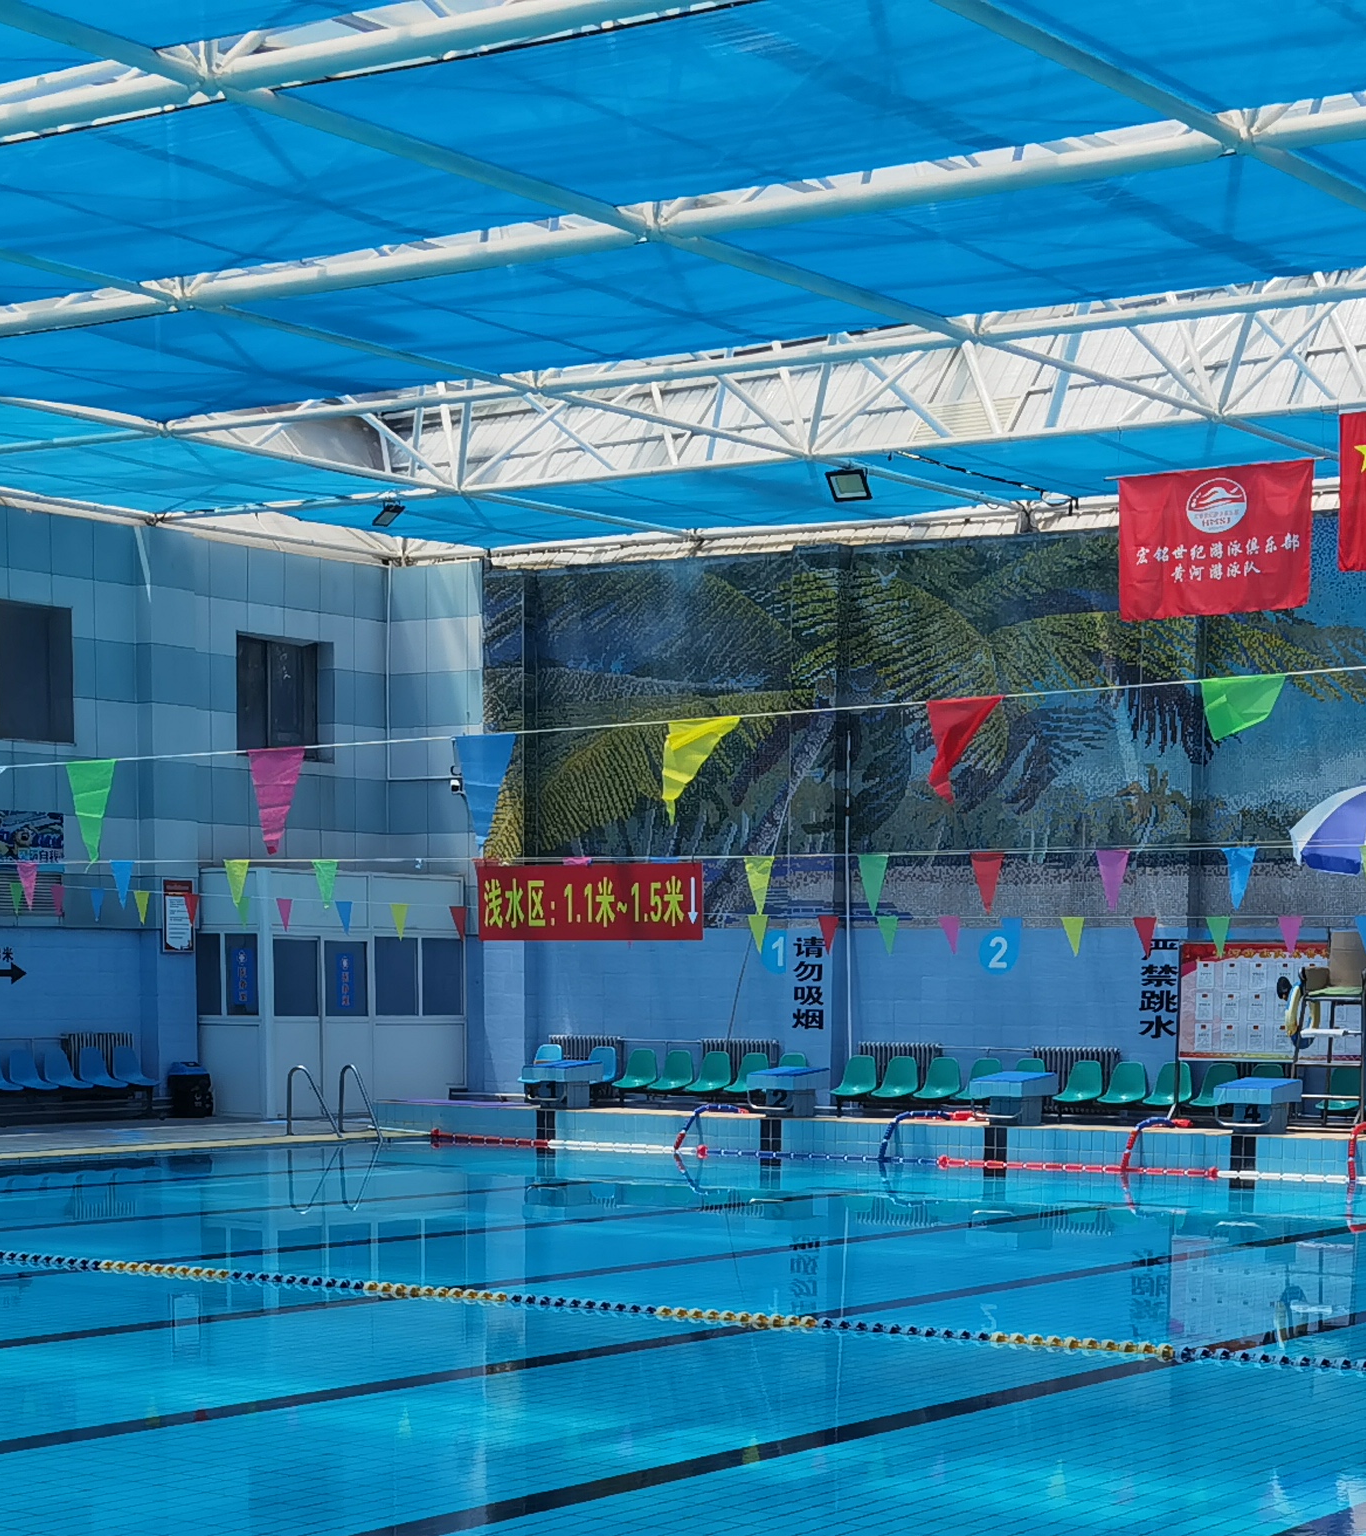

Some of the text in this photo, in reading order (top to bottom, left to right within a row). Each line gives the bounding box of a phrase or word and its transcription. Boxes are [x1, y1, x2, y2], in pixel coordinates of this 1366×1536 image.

[1136, 532, 1301, 566] 宏铭世纪游泳俱乐部
[1171, 561, 1261, 583] 黄河游泳队
[484, 876, 684, 929] 浅水区：1.1米~1.5米
[772, 936, 784, 967] 1
[988, 936, 1008, 968] 2
[792, 937, 825, 1029] 请勿吸烟
[1138, 939, 1178, 1039] 严禁跳水
[773, 1089, 787, 1107] 2
